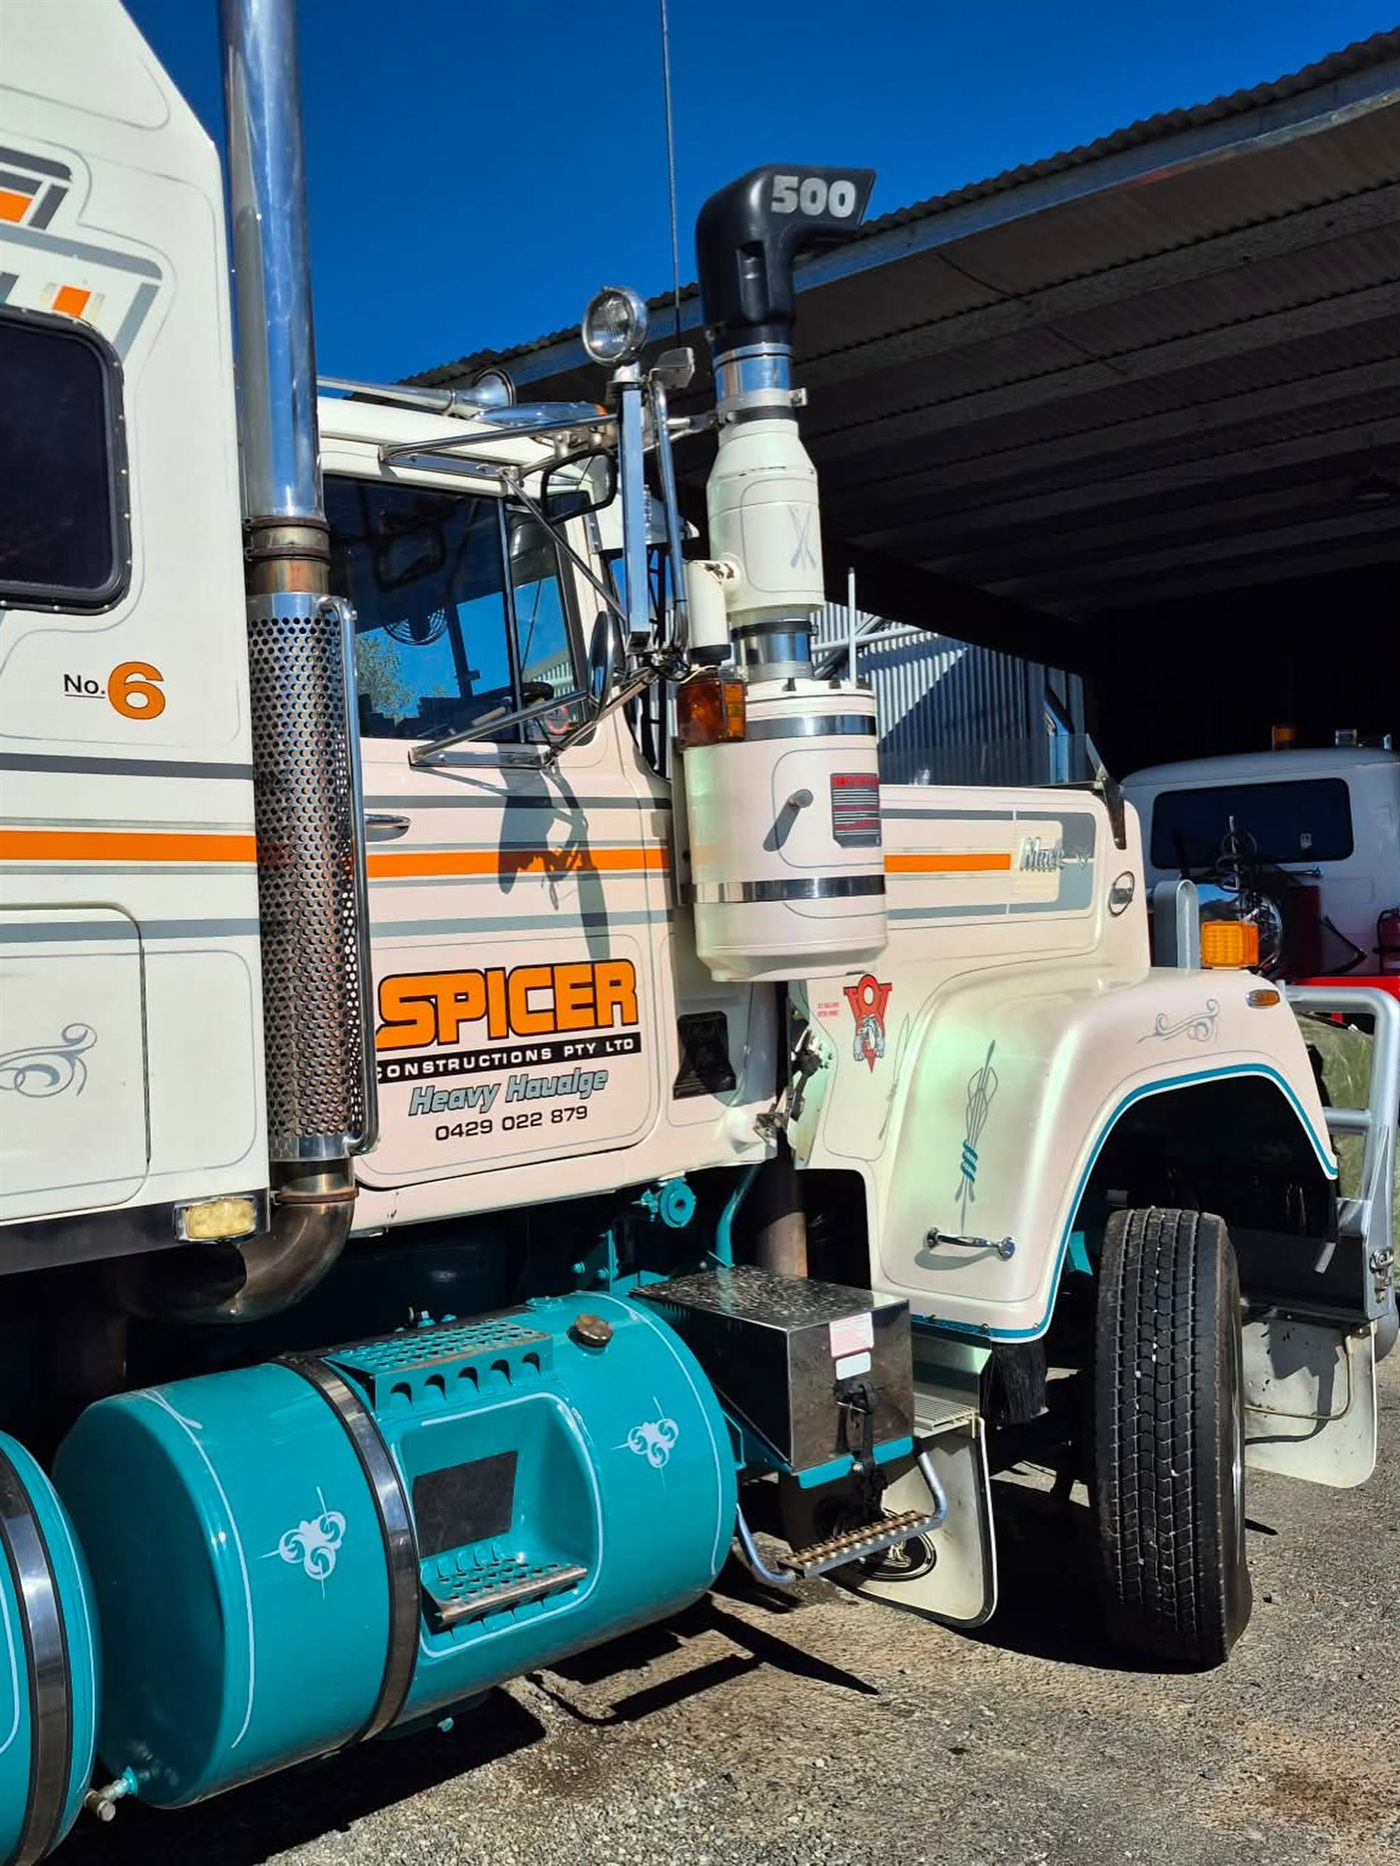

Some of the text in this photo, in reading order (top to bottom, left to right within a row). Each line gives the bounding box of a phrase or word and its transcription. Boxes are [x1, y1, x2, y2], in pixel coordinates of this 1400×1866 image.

[770, 174, 856, 219] 500
[375, 958, 640, 1053] SPICER
[564, 1042, 597, 1058] PTY
[605, 1037, 634, 1051] LTD
[408, 1082, 501, 1116] Heavy
[435, 1104, 588, 1141] 0429 022 879
